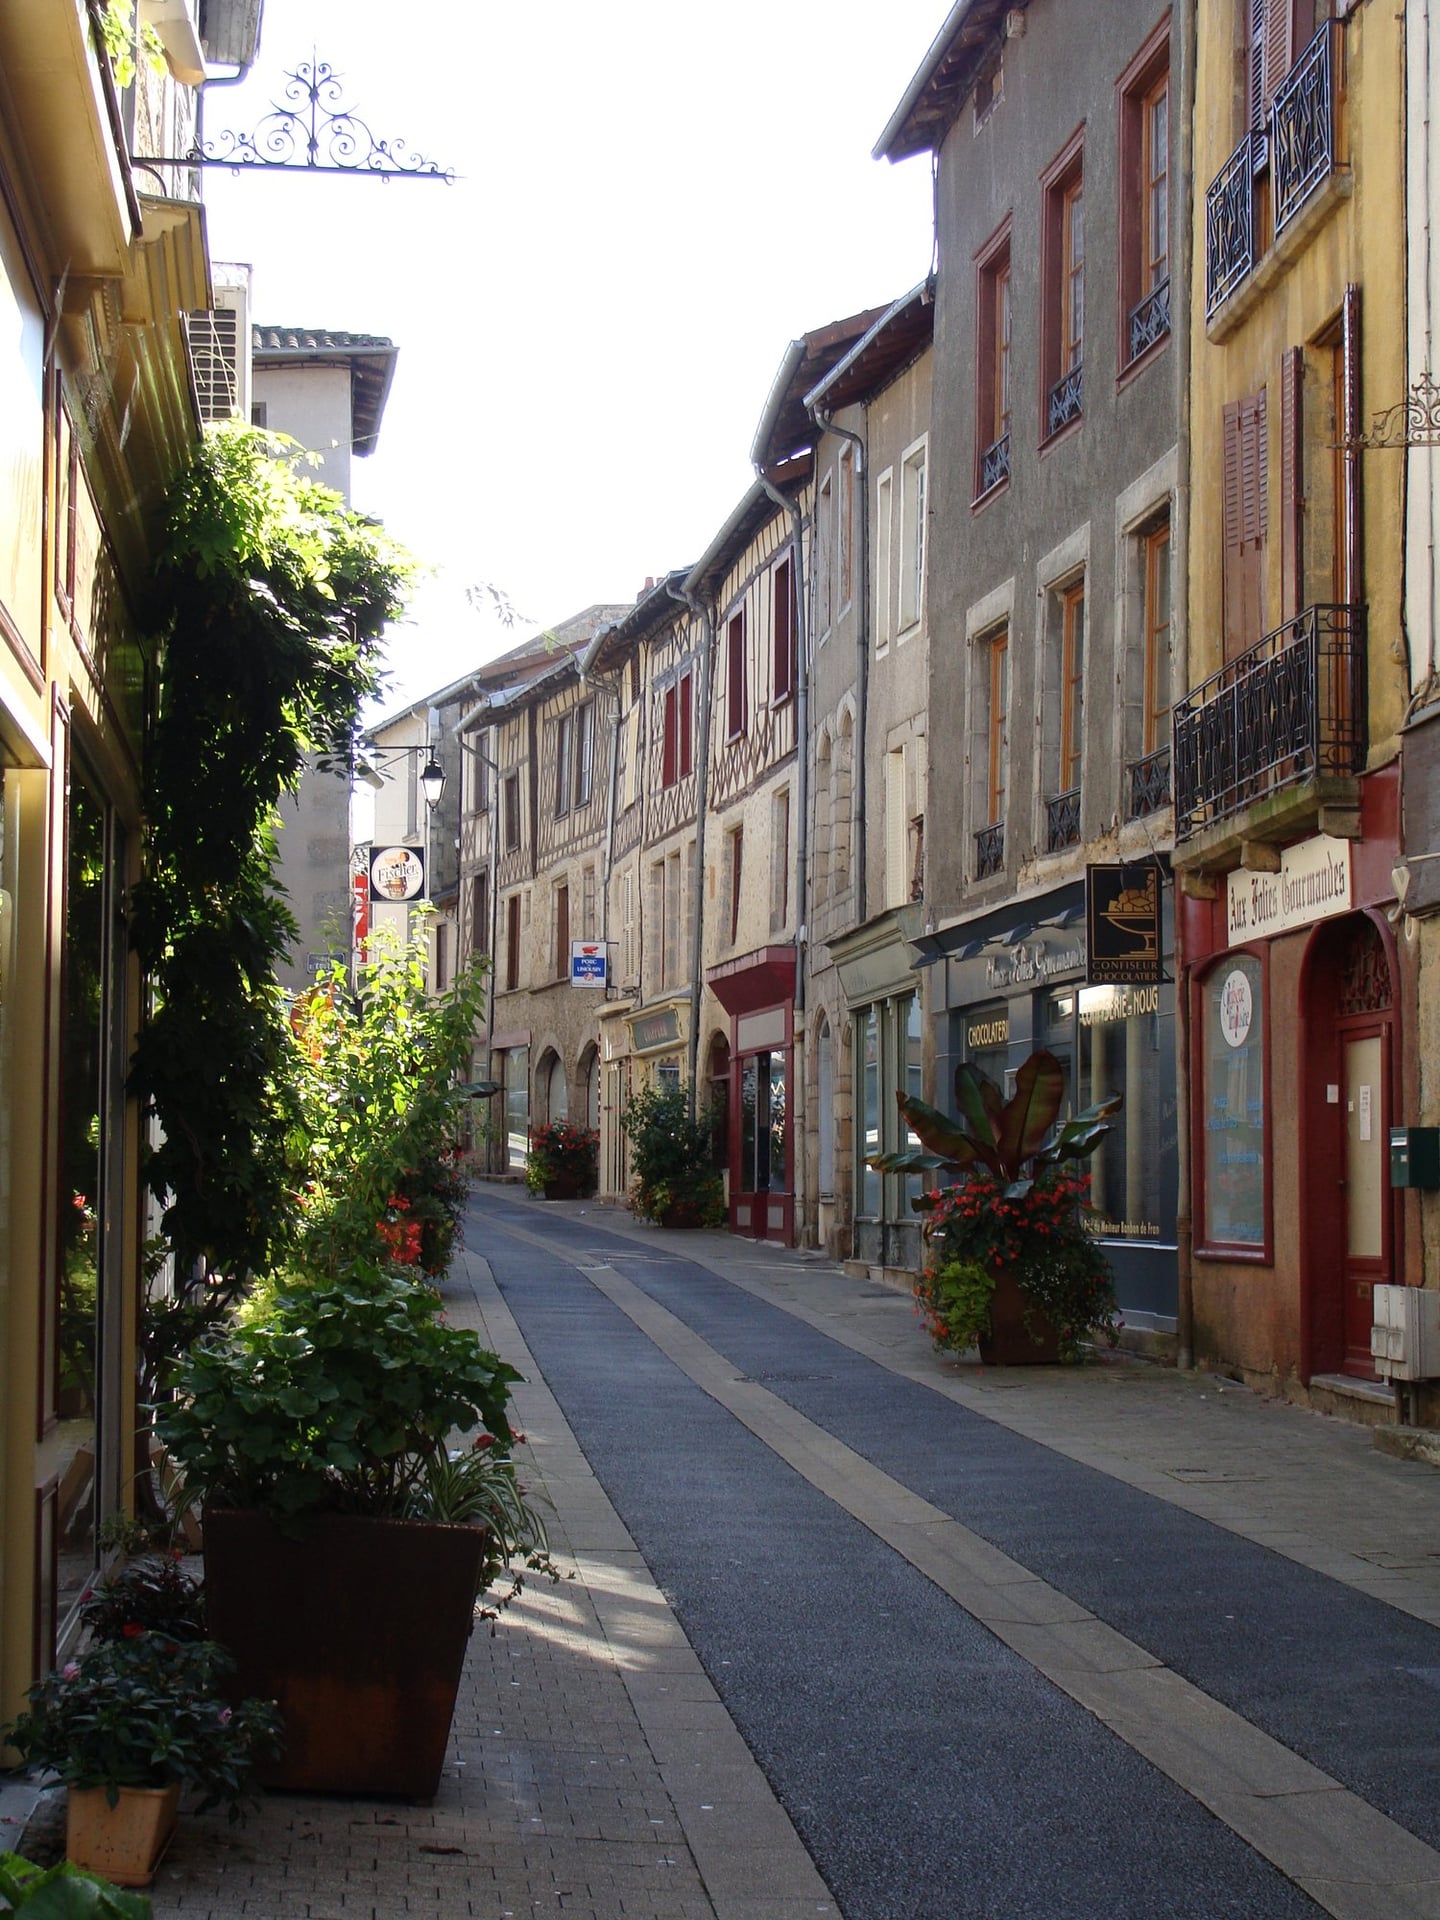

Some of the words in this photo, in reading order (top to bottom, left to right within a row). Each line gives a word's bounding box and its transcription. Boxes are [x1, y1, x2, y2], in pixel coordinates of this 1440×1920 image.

[378, 863, 417, 882] Fischer
[1230, 886, 1247, 931] Aux
[1281, 851, 1345, 916] Gourmandes
[1092, 960, 1158, 970] CONFISEUR
[1092, 972, 1158, 980] CHOCOLATIER
